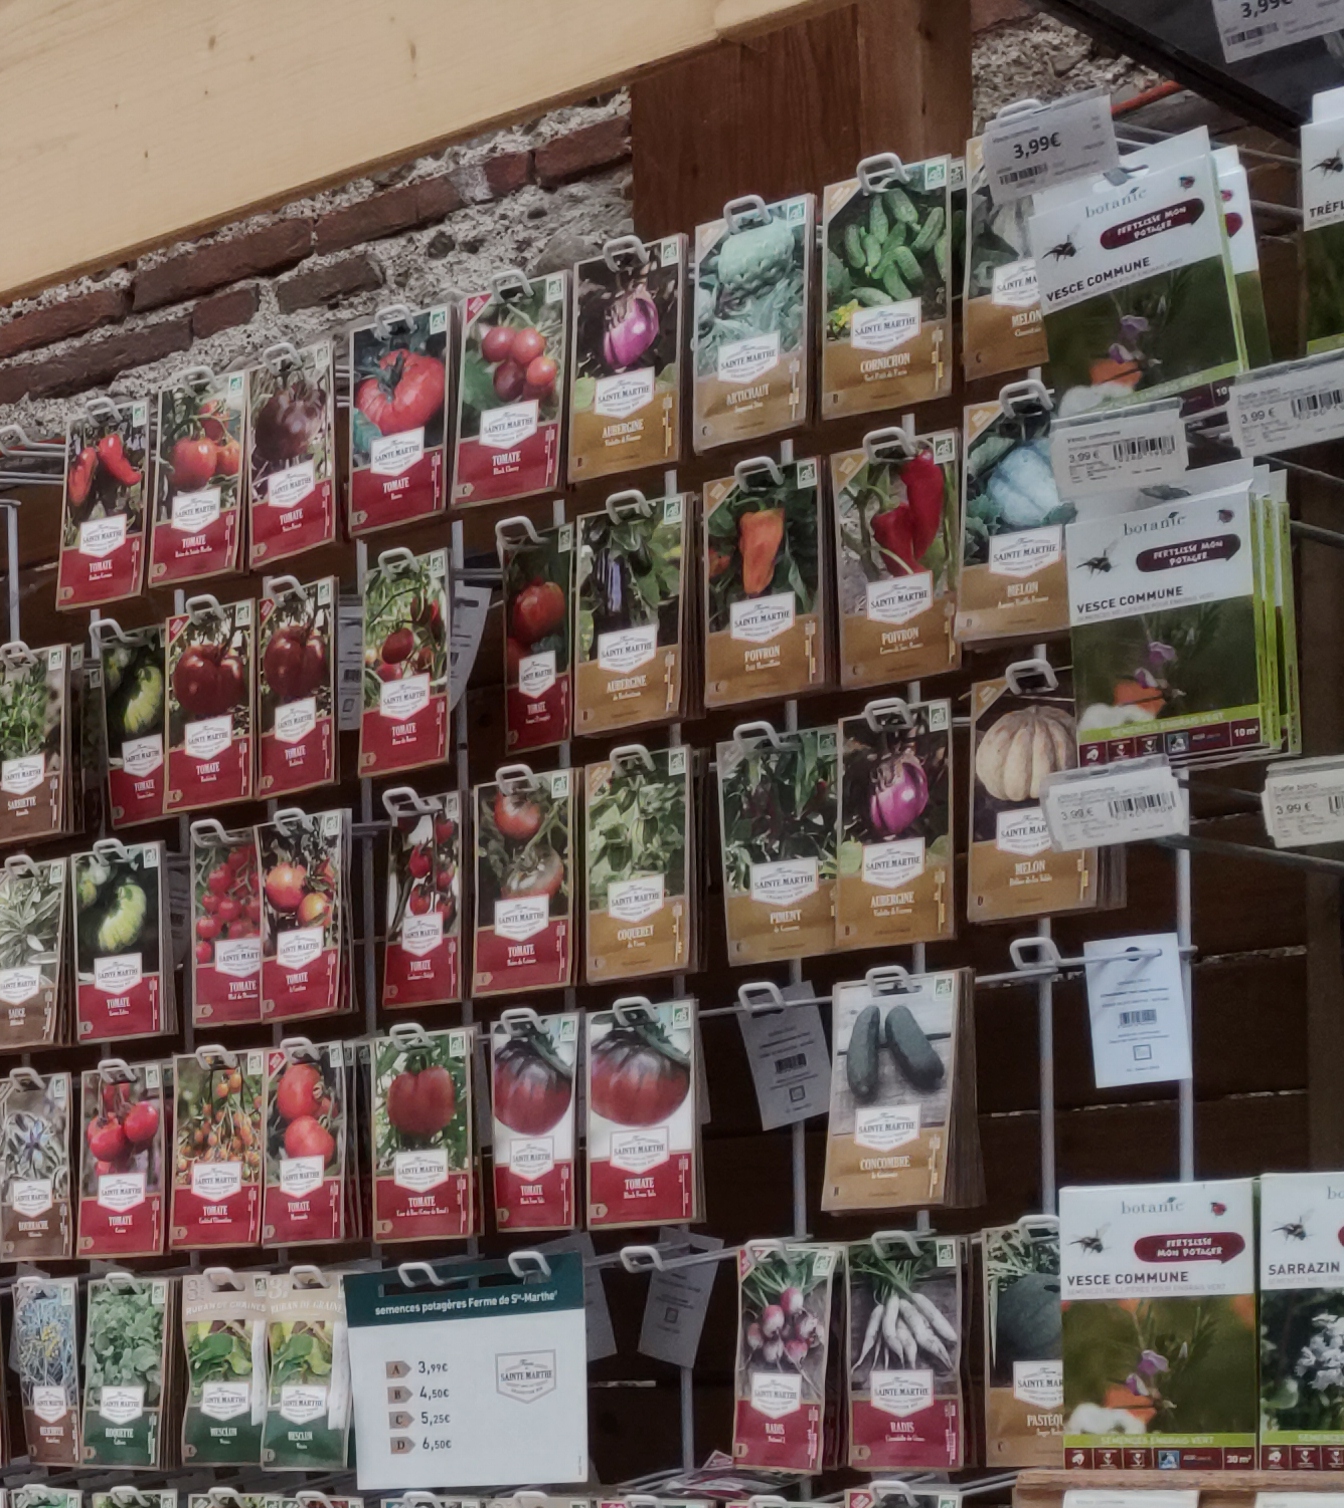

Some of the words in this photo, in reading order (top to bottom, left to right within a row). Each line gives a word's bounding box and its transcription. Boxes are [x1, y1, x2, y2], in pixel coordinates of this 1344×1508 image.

[1241, 0, 1293, 18] 3,99
[1013, 132, 1061, 159] 3,99€
[1085, 187, 1147, 218] botanic
[1164, 205, 1187, 220] MON
[1134, 219, 1172, 240] POTAGER
[1046, 279, 1084, 303] VESCE
[1086, 255, 1151, 288] COMMUNE
[854, 324, 882, 337] SAINTE
[884, 316, 917, 331] MARTHE
[860, 353, 911, 373] CORNICHON
[1124, 511, 1186, 537] botanic
[1201, 538, 1223, 550] MON
[1169, 551, 1208, 567] POTAGER
[1076, 597, 1117, 615] VESCE
[1119, 586, 1183, 606] COMMUNE
[1234, 727, 1247, 739] 10
[1015, 859, 1046, 875] MELON
[858, 1122, 883, 1134] SAINTE
[885, 1120, 917, 1131] MARTHE
[860, 1155, 911, 1170] CONCOMBRE
[624, 1177, 655, 1190] TOMATE
[1121, 1197, 1184, 1215] botanic
[1157, 1247, 1180, 1257] MON
[1182, 1245, 1223, 1256] POTAGER
[1268, 1262, 1341, 1276] SARRAZIN
[1067, 1273, 1113, 1286] VESCE
[1115, 1271, 1189, 1284] COMMUNE
[375, 1303, 420, 1316] semences
[422, 1298, 467, 1314] potagères
[468, 1296, 497, 1309] Ferme
[499, 1295, 510, 1305] de
[392, 1364, 400, 1374] A
[418, 1361, 448, 1375] 3,99€
[500, 1372, 525, 1382] SAINTE
[525, 1370, 552, 1379] MARTHE
[394, 1390, 401, 1400] B
[419, 1386, 450, 1400] 4,50€
[395, 1415, 403, 1425] C
[421, 1411, 451, 1426] 5,25€
[397, 1440, 405, 1450] D
[422, 1436, 452, 1451] 6,50€
[1226, 1455, 1239, 1465] 30
